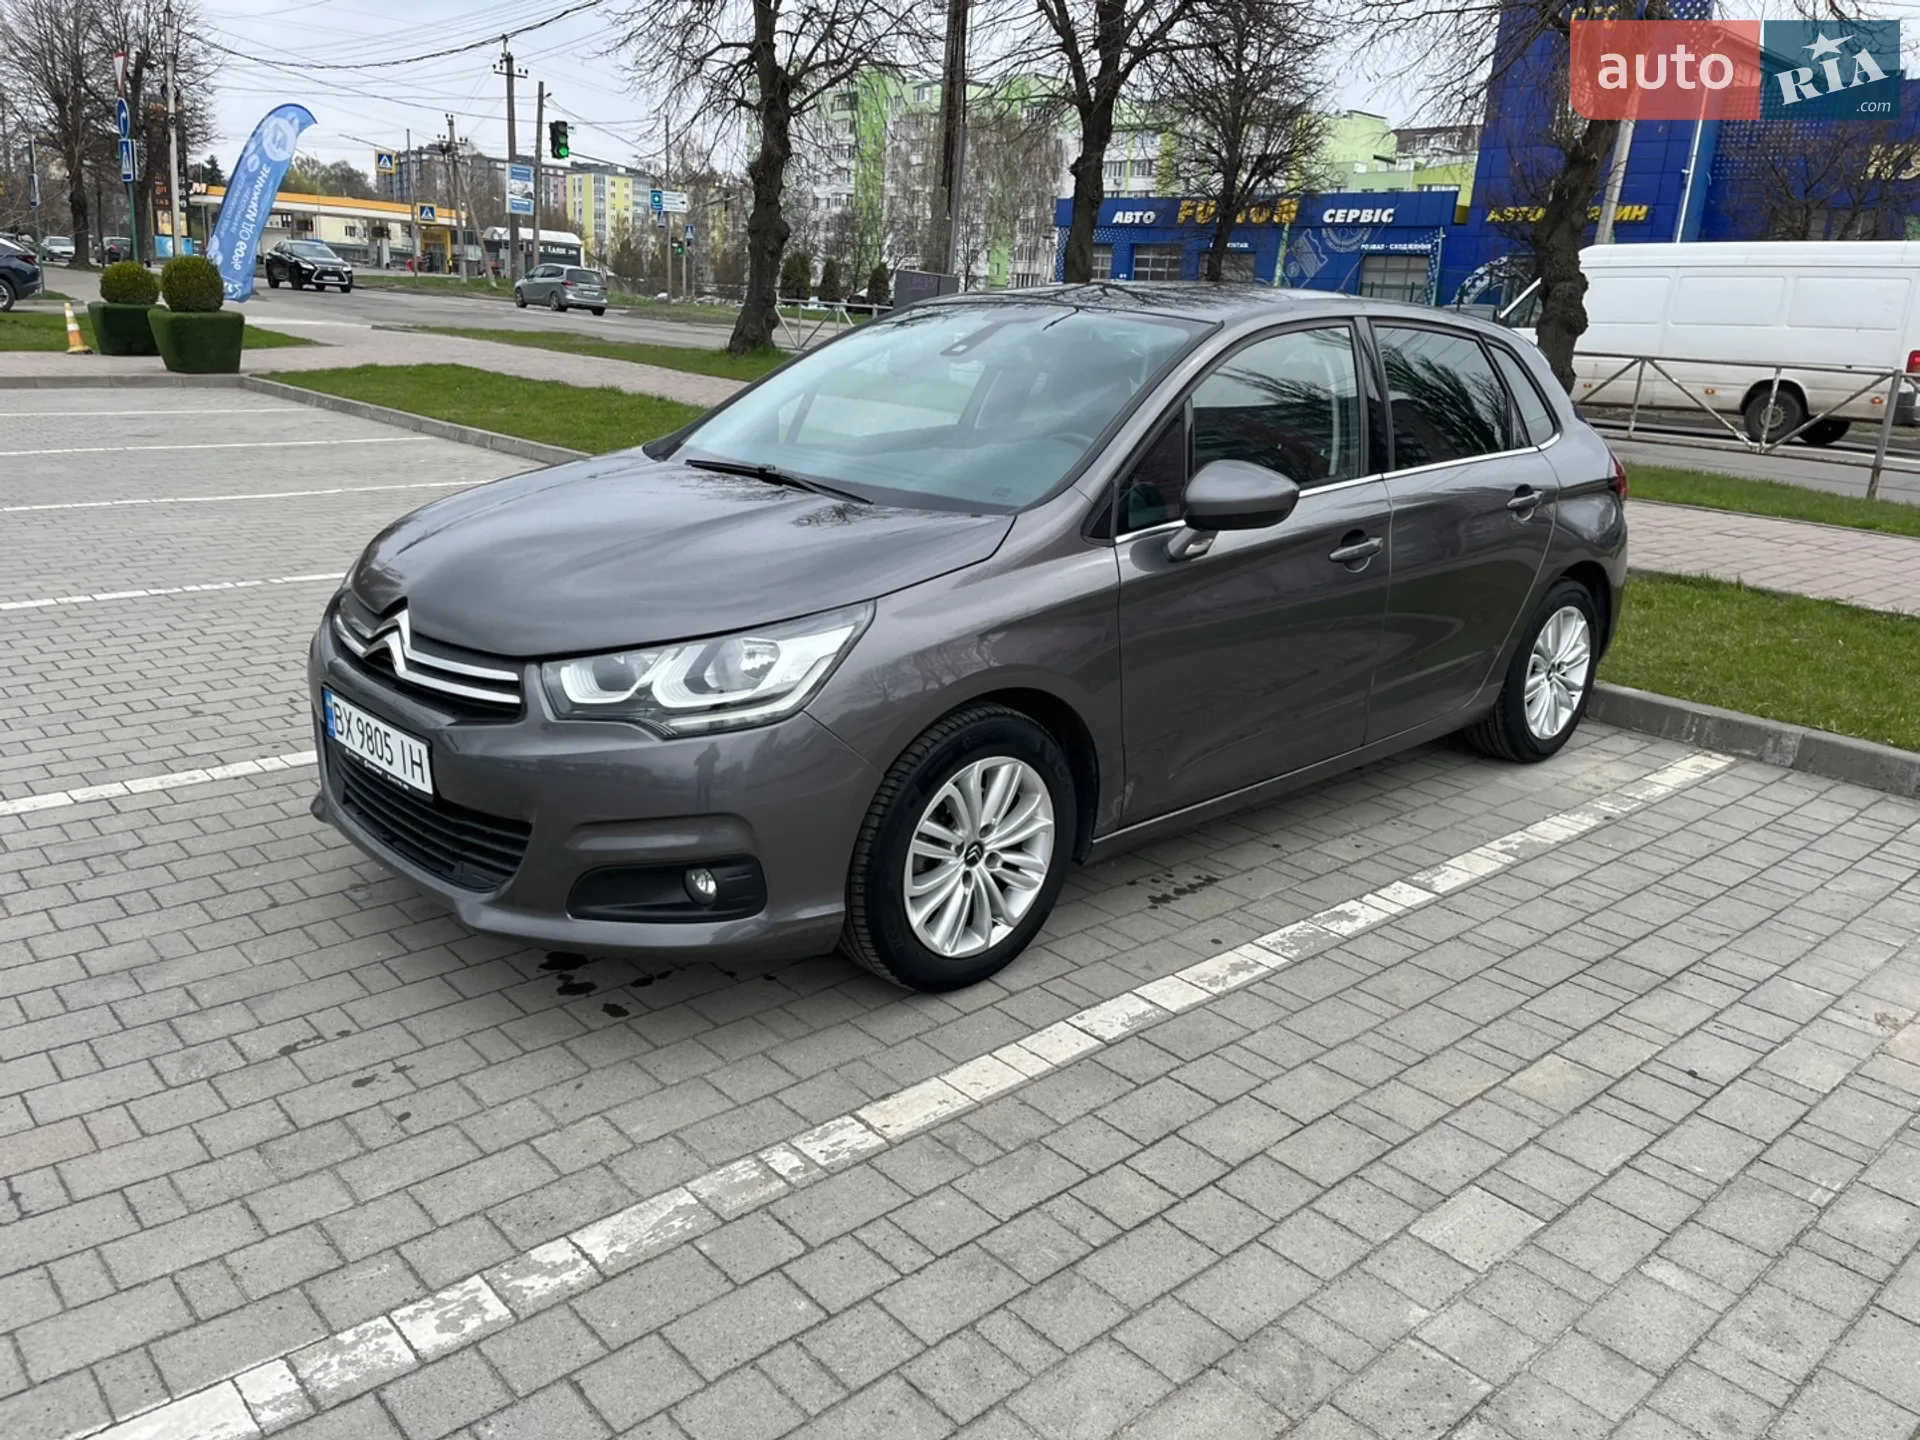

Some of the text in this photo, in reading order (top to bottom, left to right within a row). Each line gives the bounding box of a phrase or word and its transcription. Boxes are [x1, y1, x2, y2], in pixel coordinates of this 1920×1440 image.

[1112, 211, 1156, 224] АВТО
[1323, 208, 1395, 224] СЕРВІС
[333, 701, 425, 785] BX 9805 IH
